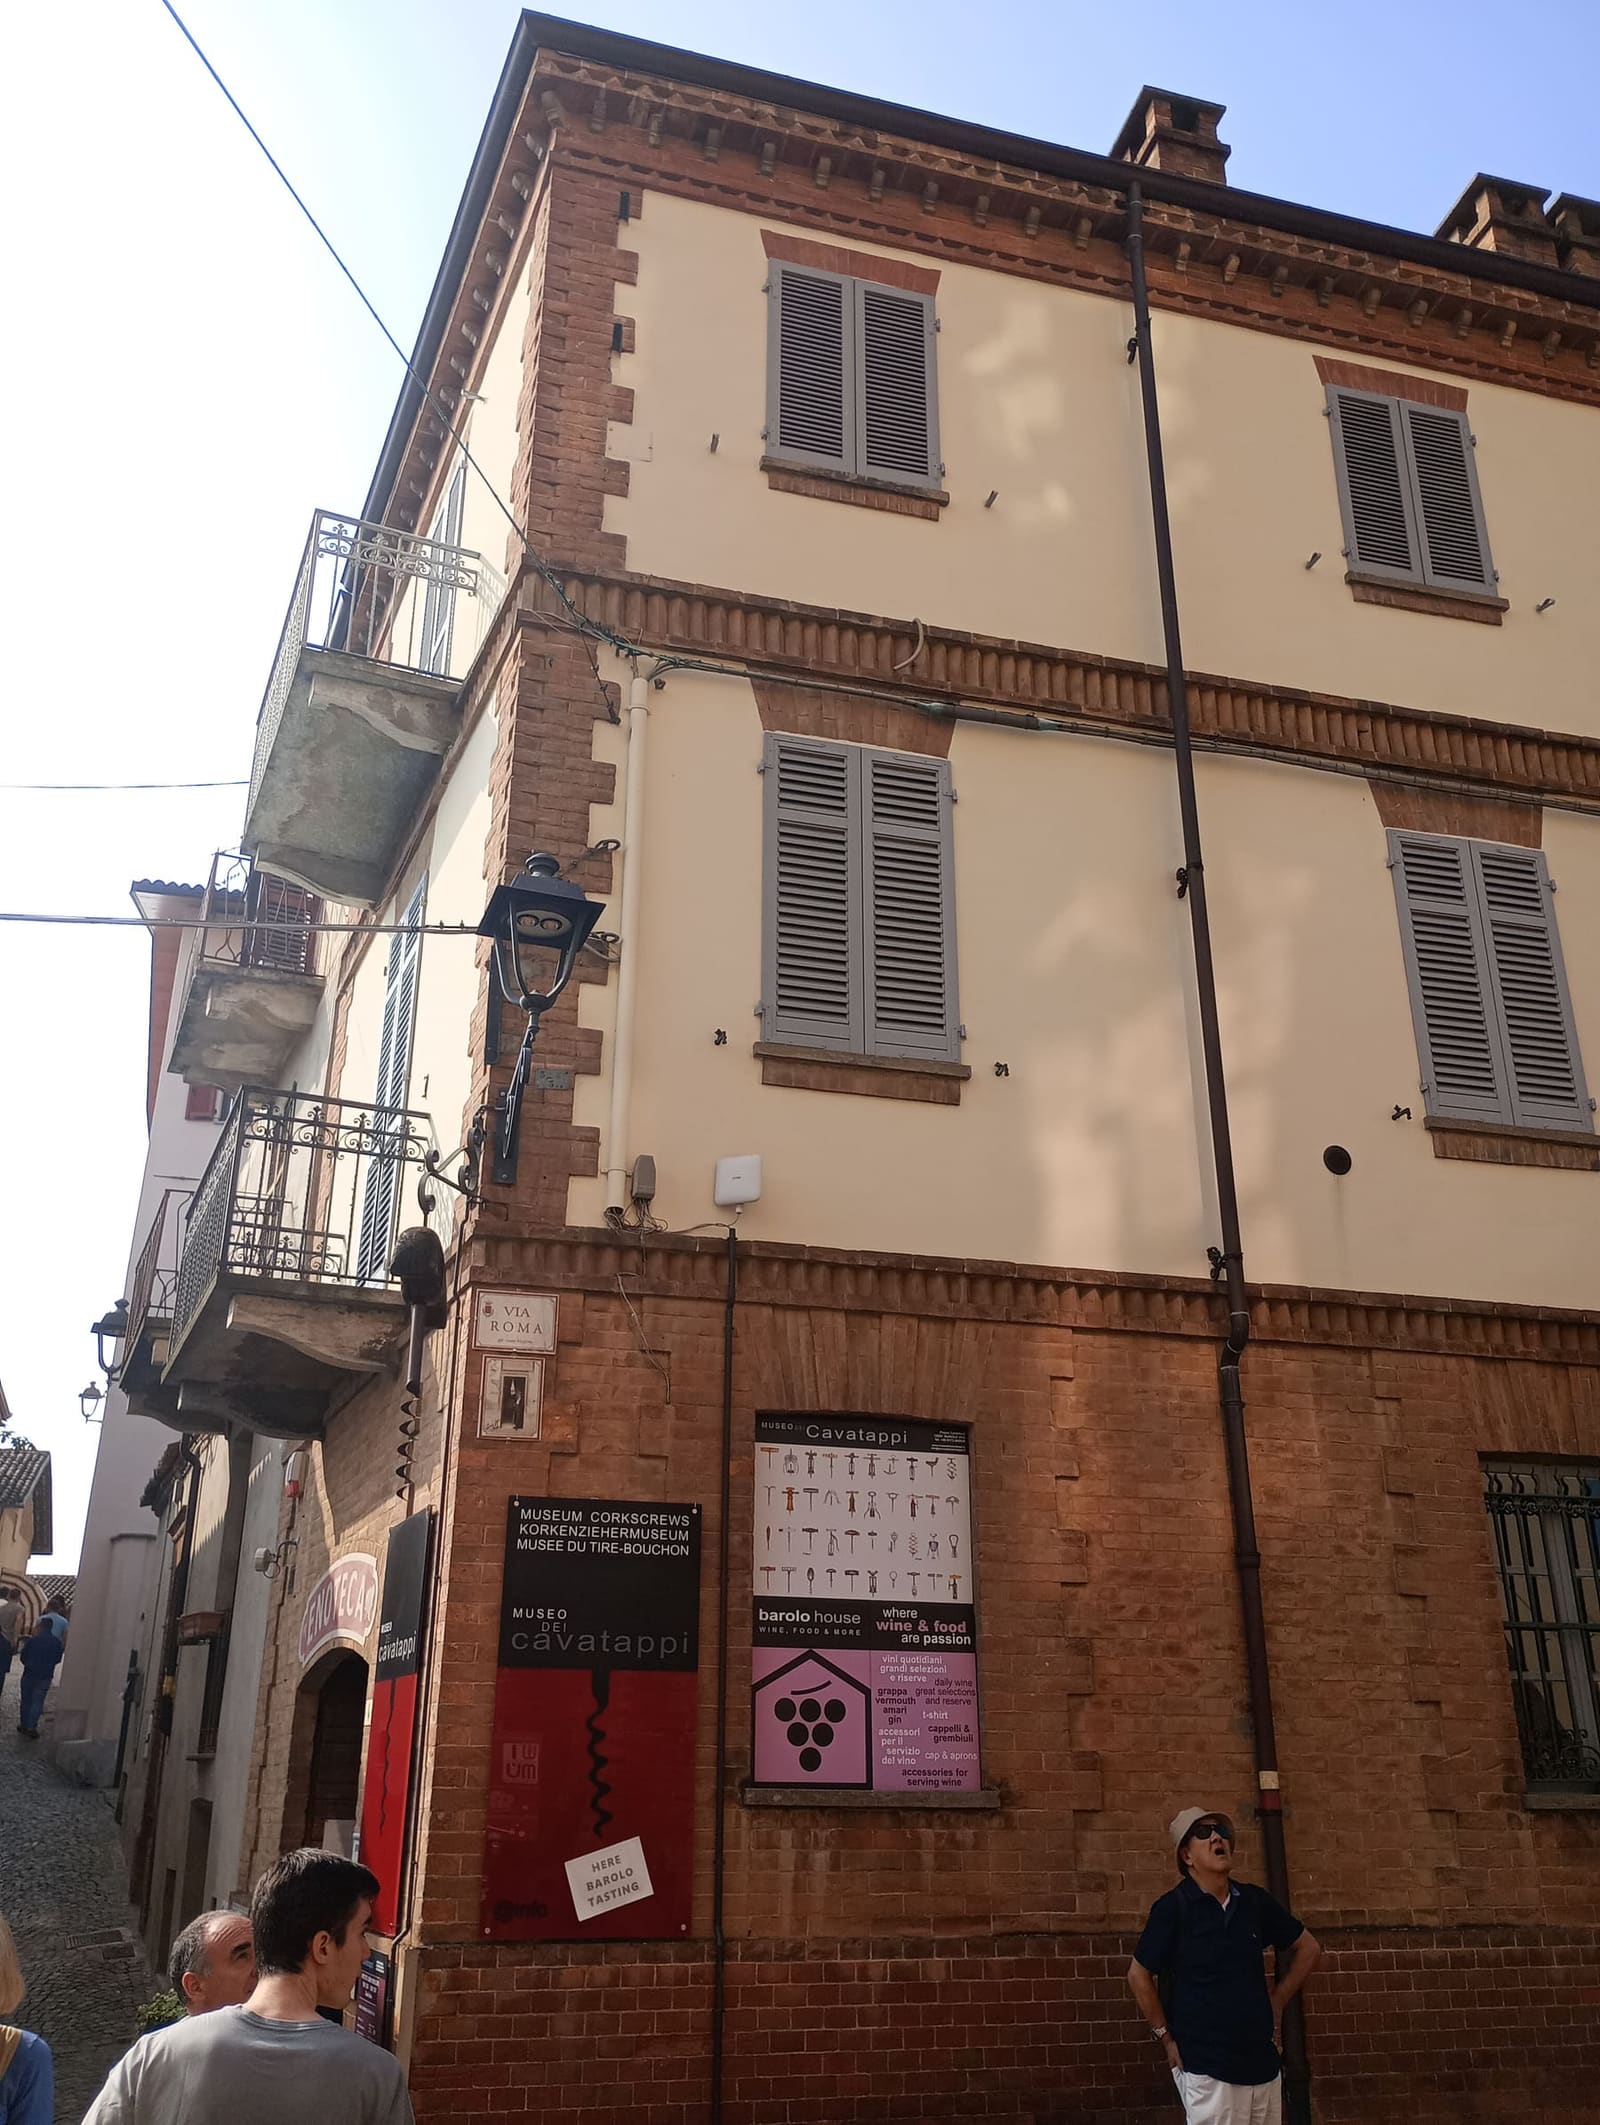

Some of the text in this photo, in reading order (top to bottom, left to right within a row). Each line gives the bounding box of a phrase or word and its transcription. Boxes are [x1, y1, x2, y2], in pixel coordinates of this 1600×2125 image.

[504, 1306, 530, 1318] VIA
[490, 1320, 543, 1334] ROMA
[761, 1422, 794, 1430] MUSEO
[805, 1425, 907, 1445] Cavatappi
[520, 1509, 690, 1526] MUSEUM CORKSCREWS
[519, 1524, 689, 1541] KORKENZIEHERMUSEUM
[517, 1539, 689, 1556] MUSEE DU TIRE-BOUCHON
[307, 1570, 366, 1646] ENOTECA
[883, 1607, 918, 1619] where
[512, 1608, 567, 1620] MUSEO
[759, 1608, 861, 1624] barolo house
[542, 1621, 567, 1633] DEI
[759, 1626, 789, 1635] WINE,
[793, 1627, 820, 1635] FOOD
[834, 1628, 861, 1636] MORE
[876, 1620, 967, 1634] wine & food
[511, 1630, 688, 1658] cavatappi
[901, 1633, 971, 1646] are passion
[378, 1631, 417, 1662] cavatappi
[882, 1655, 942, 1666] vini quotidiani
[880, 1664, 946, 1674] grandi selezioni
[898, 1674, 927, 1682] riserve
[934, 1678, 952, 1688] daily
[878, 1688, 907, 1696] grappa
[915, 1688, 976, 1697] great selections
[875, 1697, 916, 1705] vermouth
[925, 1697, 971, 1706] and reserve
[883, 1706, 907, 1714] amari
[922, 1711, 948, 1719] t-shirt
[888, 1716, 901, 1725] gin
[878, 1728, 920, 1736] accessori
[928, 1724, 970, 1734] cappelli &
[881, 1738, 896, 1746] per
[933, 1734, 973, 1744] grembiuli
[886, 1747, 920, 1755] servizio
[925, 1751, 977, 1761] cap & aprons
[882, 1756, 916, 1765] del vino
[902, 1768, 968, 1777] accessories for
[908, 1778, 939, 1788] serving
[591, 1855, 621, 1873] HERE
[586, 1867, 633, 1892] BAROLO
[587, 1882, 640, 1908] TASTING
